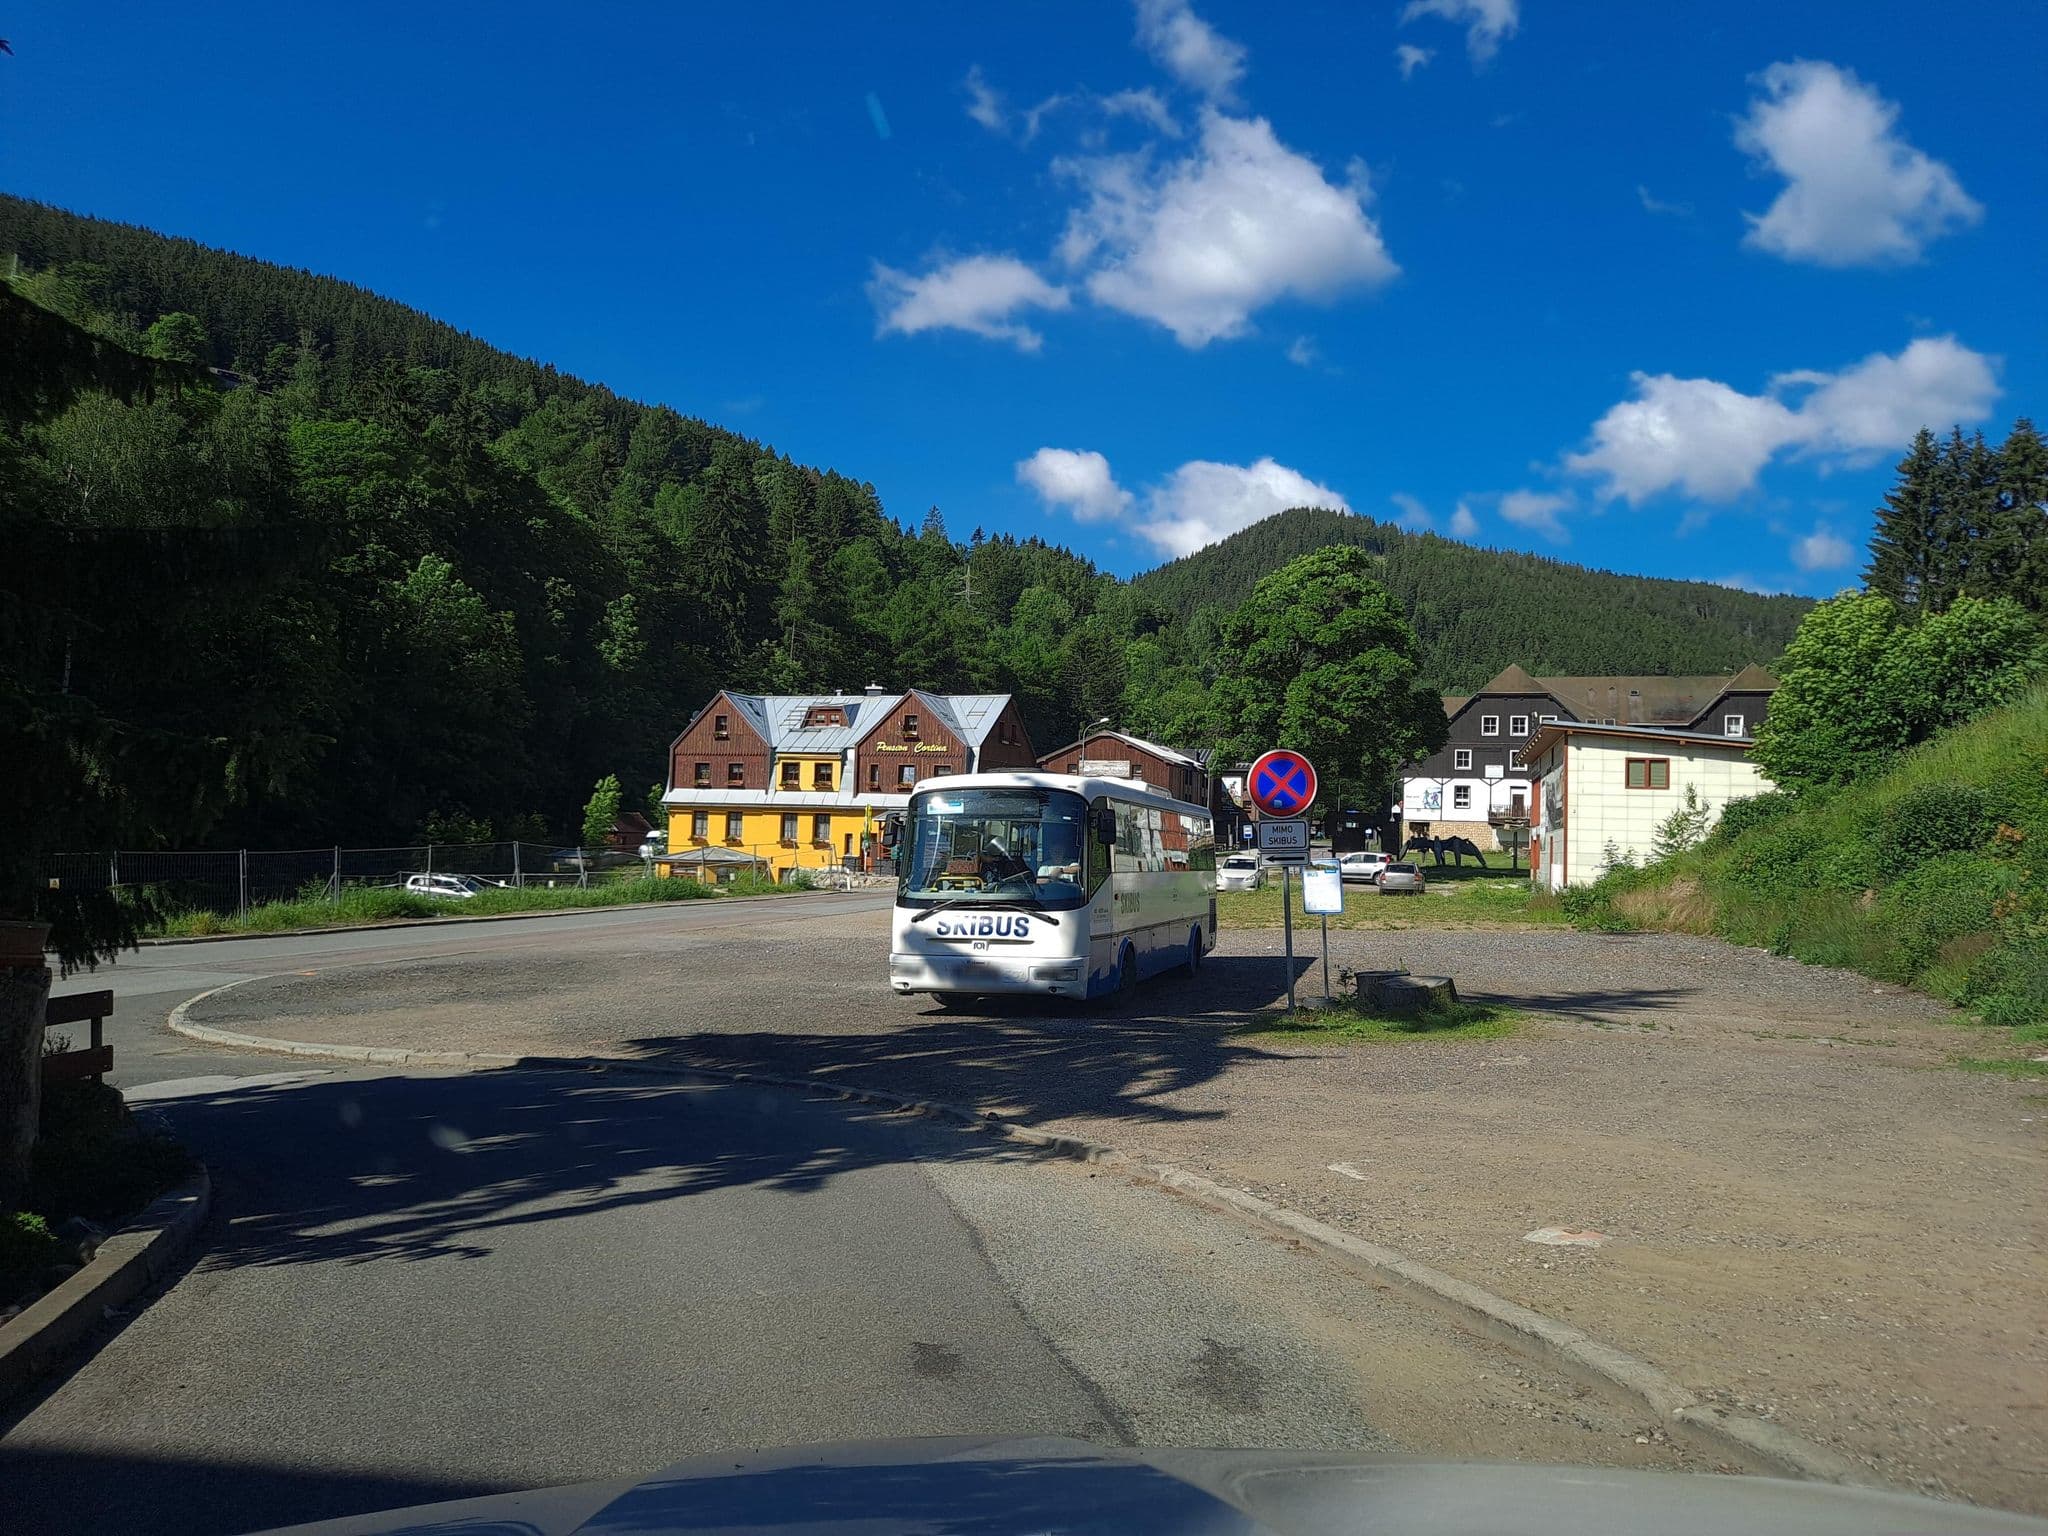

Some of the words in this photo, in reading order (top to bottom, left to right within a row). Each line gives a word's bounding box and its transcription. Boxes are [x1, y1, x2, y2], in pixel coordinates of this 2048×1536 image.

[876, 741, 908, 752] Pension
[914, 741, 948, 752] Cortina
[1272, 825, 1293, 833] MIMO
[1268, 836, 1297, 845] SKIBUS
[937, 915, 1030, 937] SKIBUS
